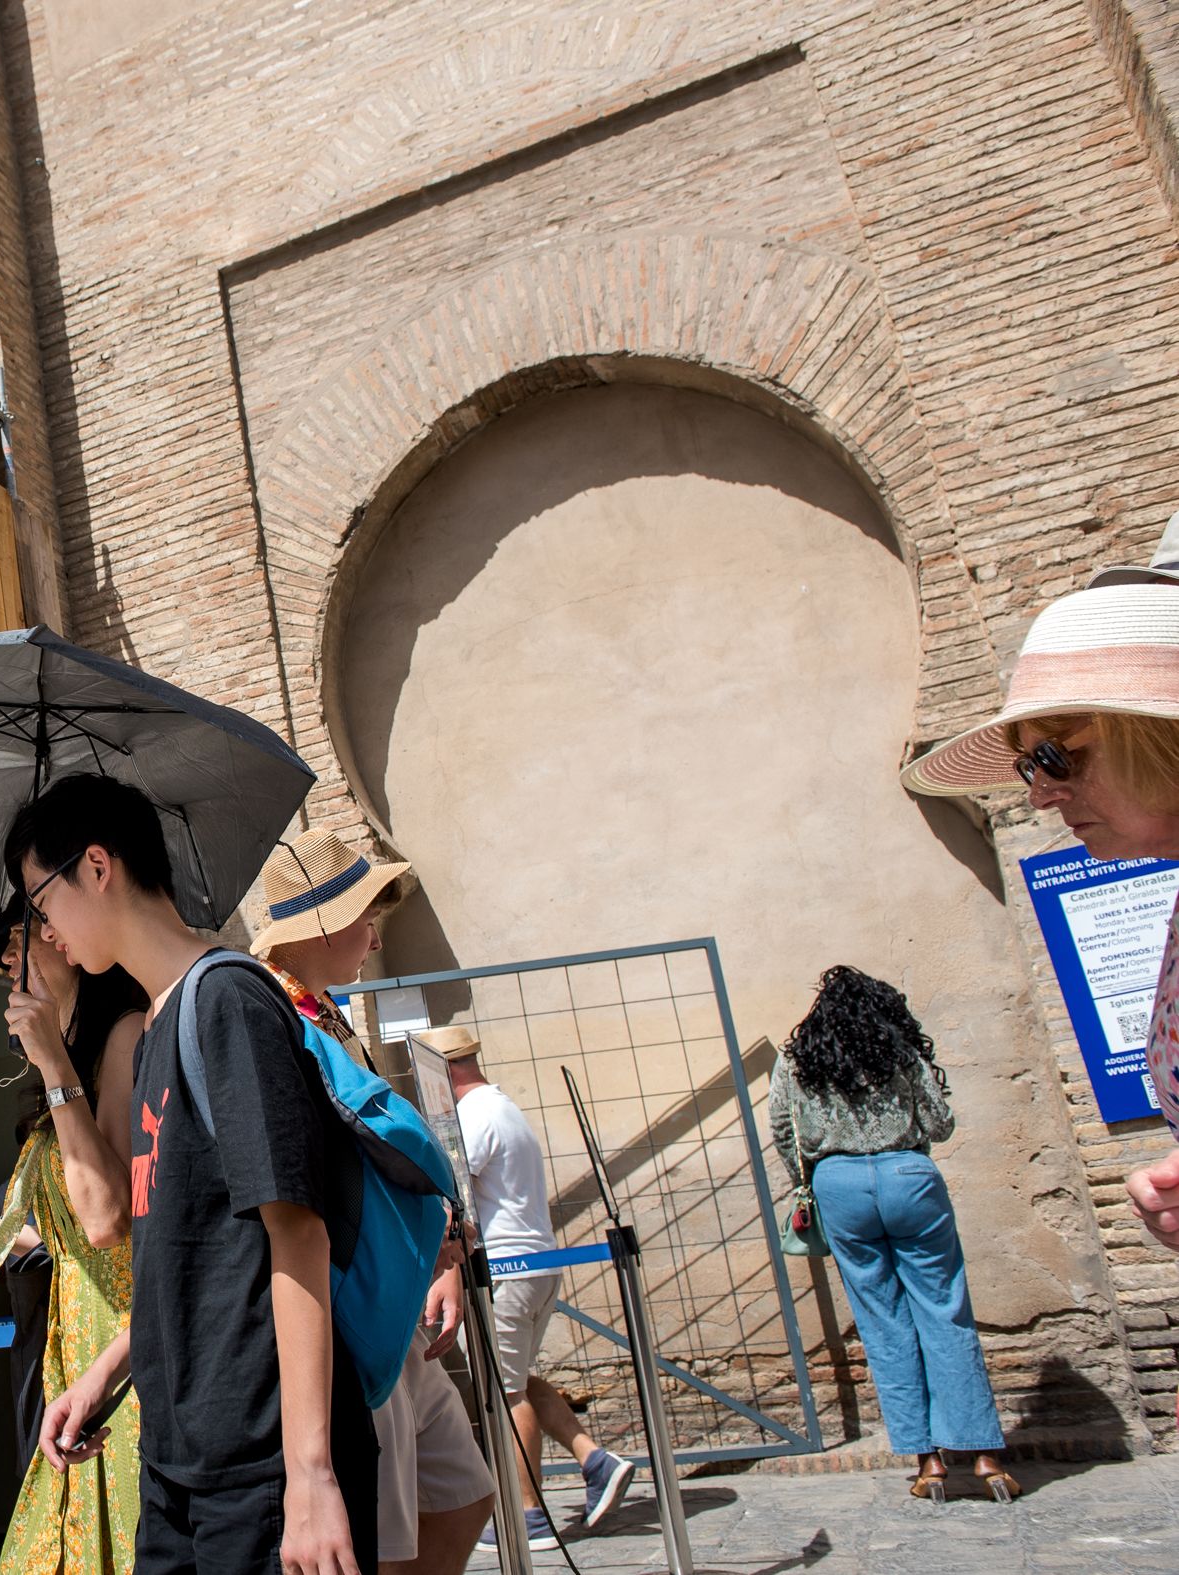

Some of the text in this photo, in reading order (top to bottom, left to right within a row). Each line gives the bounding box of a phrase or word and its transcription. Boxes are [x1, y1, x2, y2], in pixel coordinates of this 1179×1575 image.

[1032, 871, 1086, 890] ENTRANCE
[1089, 864, 1117, 878] WITH
[1117, 857, 1158, 871] ONLINE
[1033, 860, 1083, 879] ENTRADA
[1070, 873, 1176, 903] Catedral y Giralda
[1066, 883, 1179, 914] Cathedral and Giralda tow
[1094, 910, 1122, 921] LUNES
[1095, 918, 1125, 929] Monday
[1078, 923, 1154, 943] Apertura/Opening
[1080, 935, 1141, 952] Cierre/Closing
[1101, 945, 1163, 963] DOMINGOS/S
[1089, 967, 1150, 984] Cierre/Closing
[1110, 996, 1144, 1009] Iglesia
[1104, 1053, 1146, 1066] ADQUIERA
[1105, 1062, 1148, 1077] www.c
[488, 1260, 528, 1274] SEVILLA
